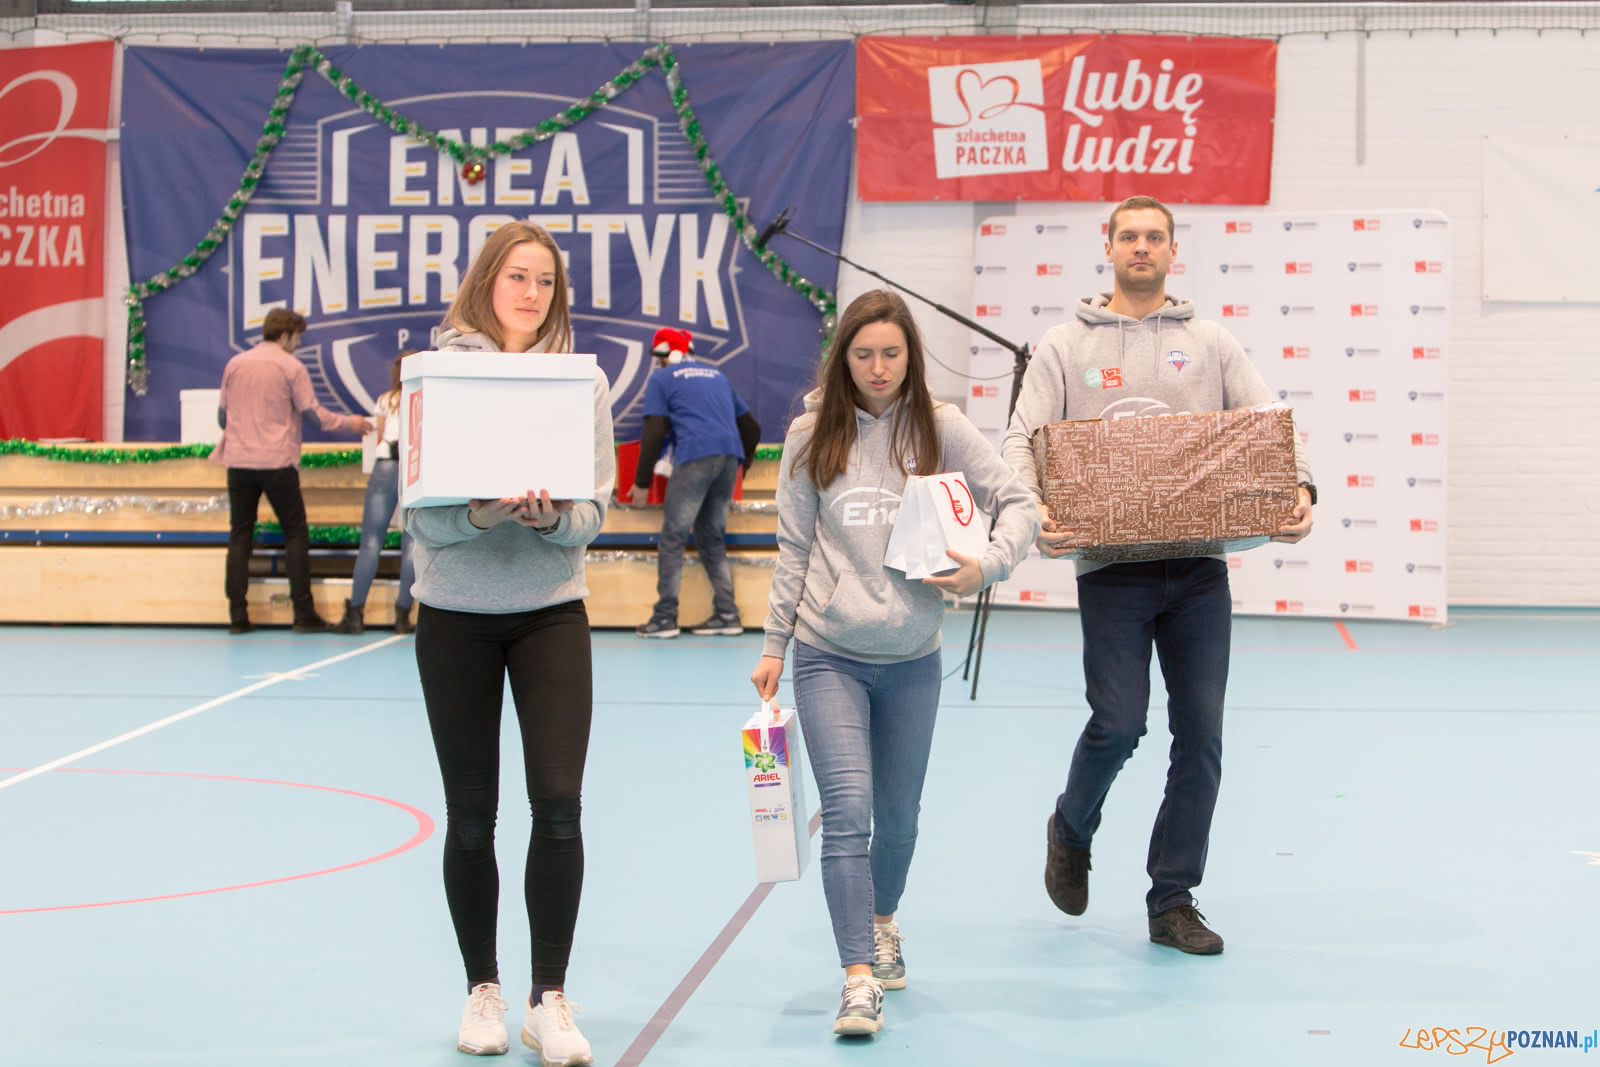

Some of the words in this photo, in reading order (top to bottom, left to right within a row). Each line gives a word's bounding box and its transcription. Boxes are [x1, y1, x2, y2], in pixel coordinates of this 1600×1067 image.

[1061, 55, 1204, 126] Lubię
[389, 127, 590, 206] ENEA
[955, 144, 1027, 165] PACZKA
[1061, 123, 1197, 174] ludzi
[753, 773, 781, 782] ARIEL
